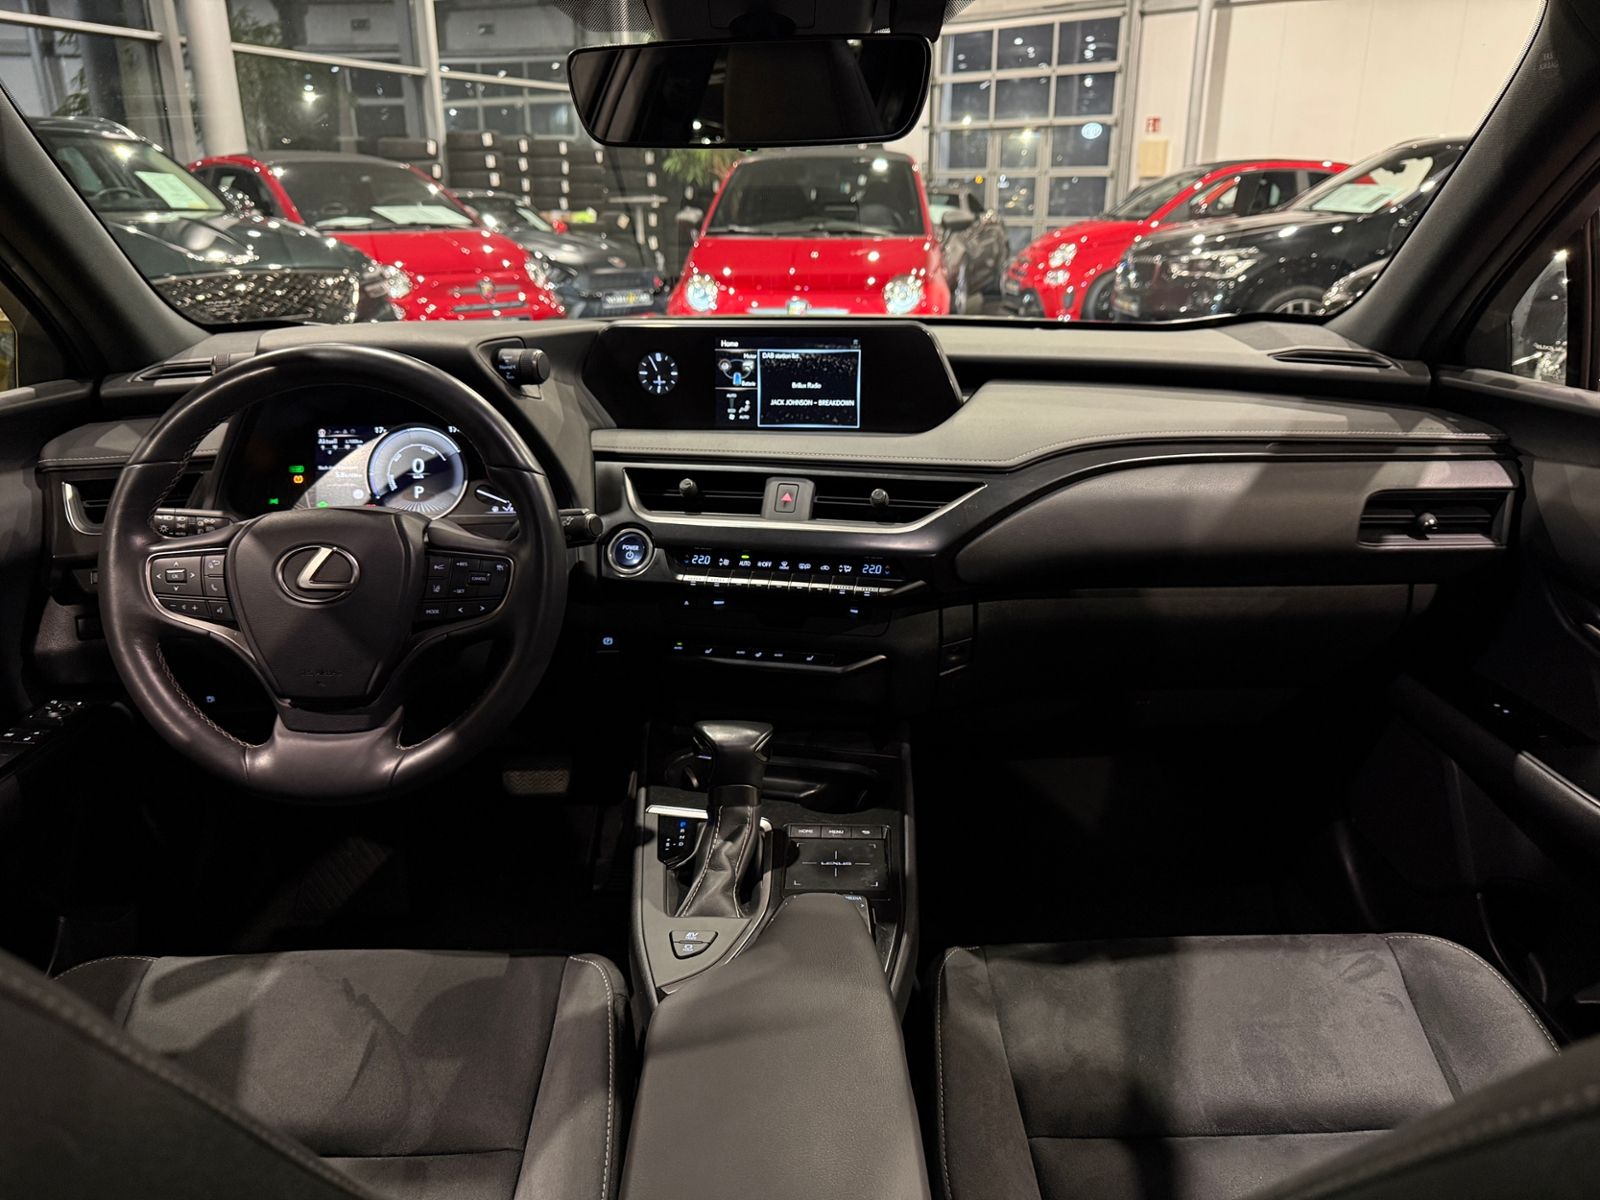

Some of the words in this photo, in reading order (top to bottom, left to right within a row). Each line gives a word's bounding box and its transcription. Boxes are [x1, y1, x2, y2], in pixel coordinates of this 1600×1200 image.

[720, 339, 739, 348] Home
[818, 399, 855, 407] BREAKDOWN
[412, 458, 425, 474] 0
[413, 485, 425, 499] P
